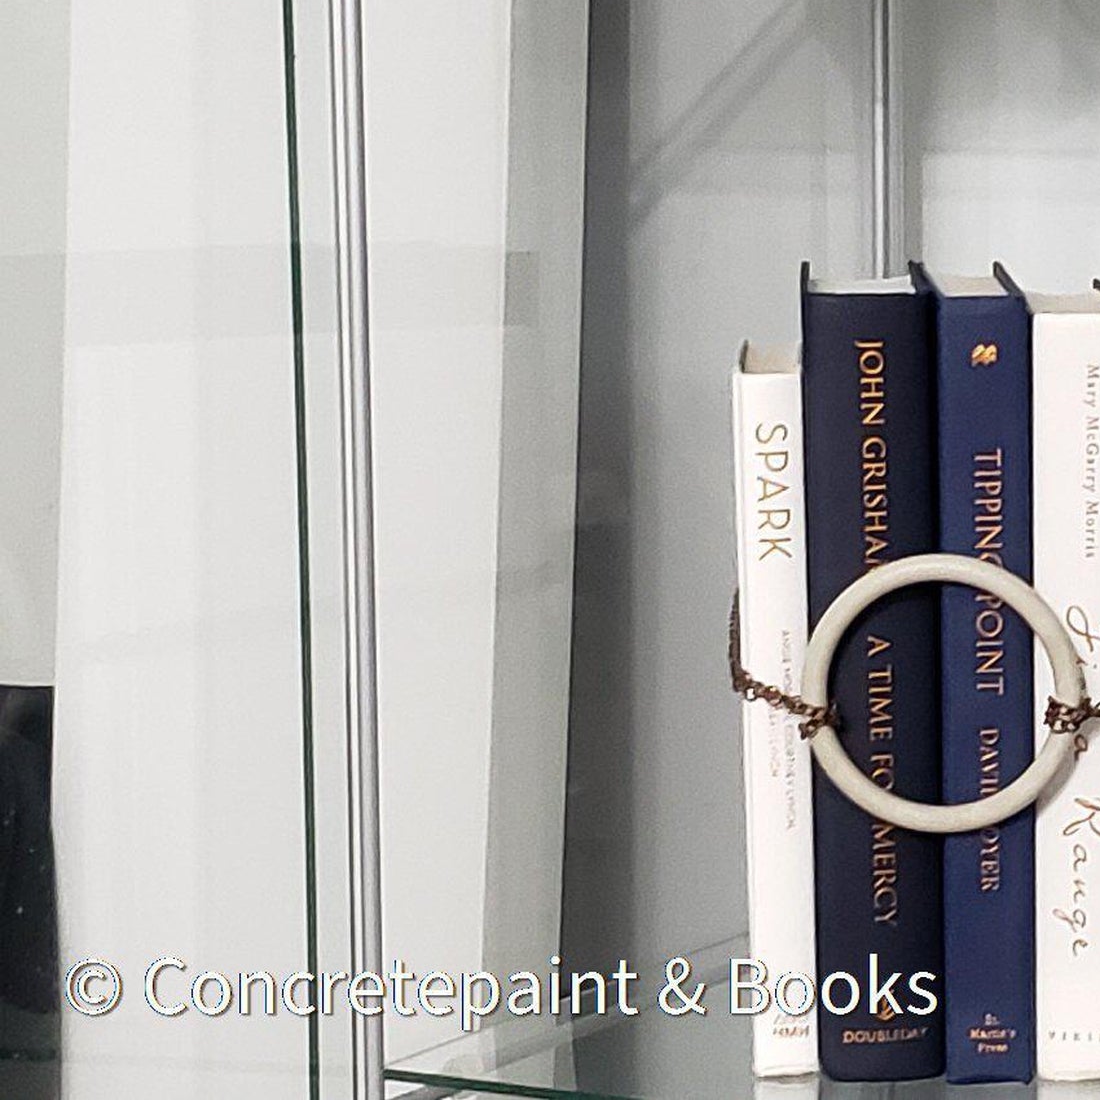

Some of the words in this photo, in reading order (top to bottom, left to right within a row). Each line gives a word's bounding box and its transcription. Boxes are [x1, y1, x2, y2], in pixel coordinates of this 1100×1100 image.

[853, 339, 886, 426] JOHN
[1082, 364, 1100, 408] Mary
[1081, 416, 1100, 493] McGarry
[755, 422, 794, 563] SPARK
[861, 436, 890, 568] GRISHA
[1084, 500, 1100, 559] Morris
[866, 634, 892, 658] A
[868, 664, 894, 742] TIME
[869, 753, 895, 792] FO
[870, 821, 898, 928] MERCY
[979, 826, 1001, 892] OYER
[841, 1027, 928, 1044] DOUBLEDAY
